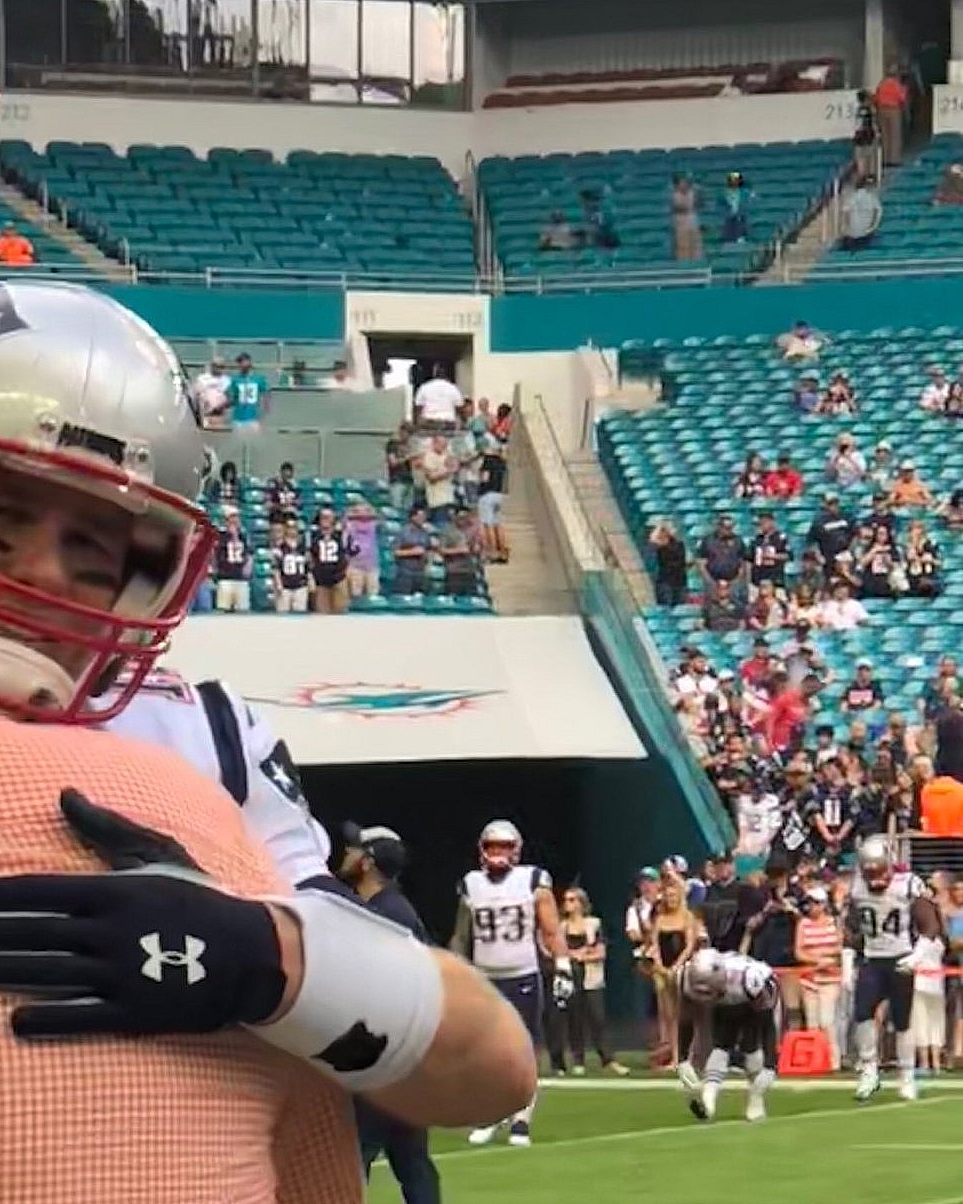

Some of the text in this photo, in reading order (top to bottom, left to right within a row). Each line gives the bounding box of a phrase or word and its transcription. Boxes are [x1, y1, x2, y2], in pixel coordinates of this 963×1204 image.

[319, 541, 339, 562] 12
[474, 904, 524, 943] 93
[789, 1036, 816, 1068] G
